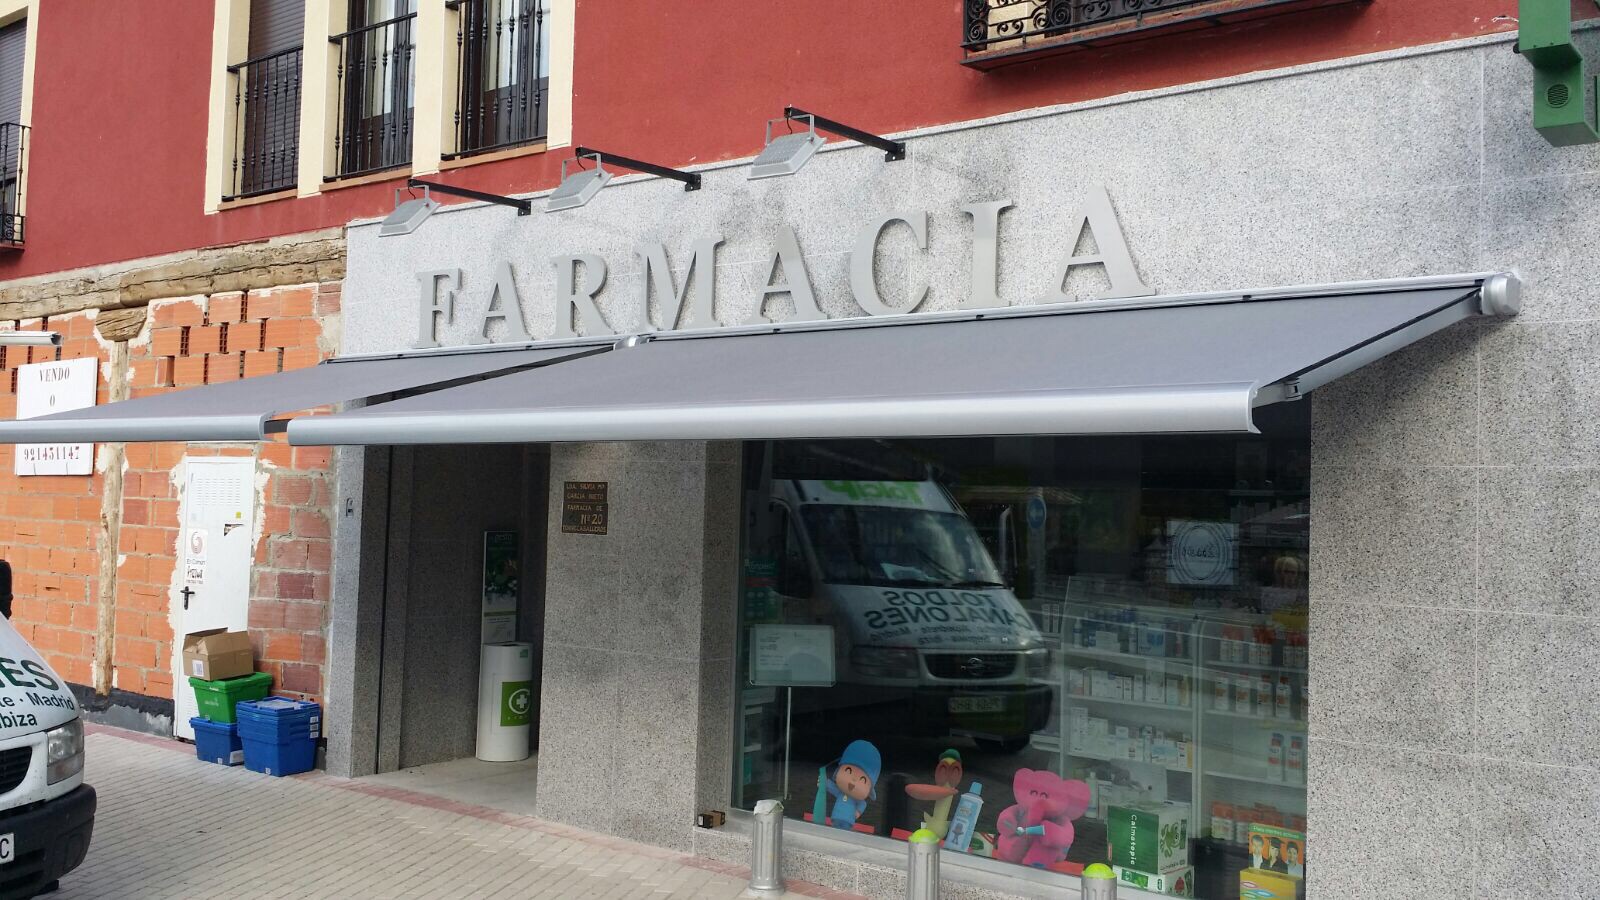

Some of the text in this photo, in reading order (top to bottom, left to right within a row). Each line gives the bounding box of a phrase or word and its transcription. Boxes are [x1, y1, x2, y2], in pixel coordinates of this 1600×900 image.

[416, 183, 1158, 349] FARMACIA
[40, 367, 70, 382] VENDO
[592, 514, 603, 525] 20
[0, 657, 59, 690] ES
[26, 692, 75, 711] Madrid
